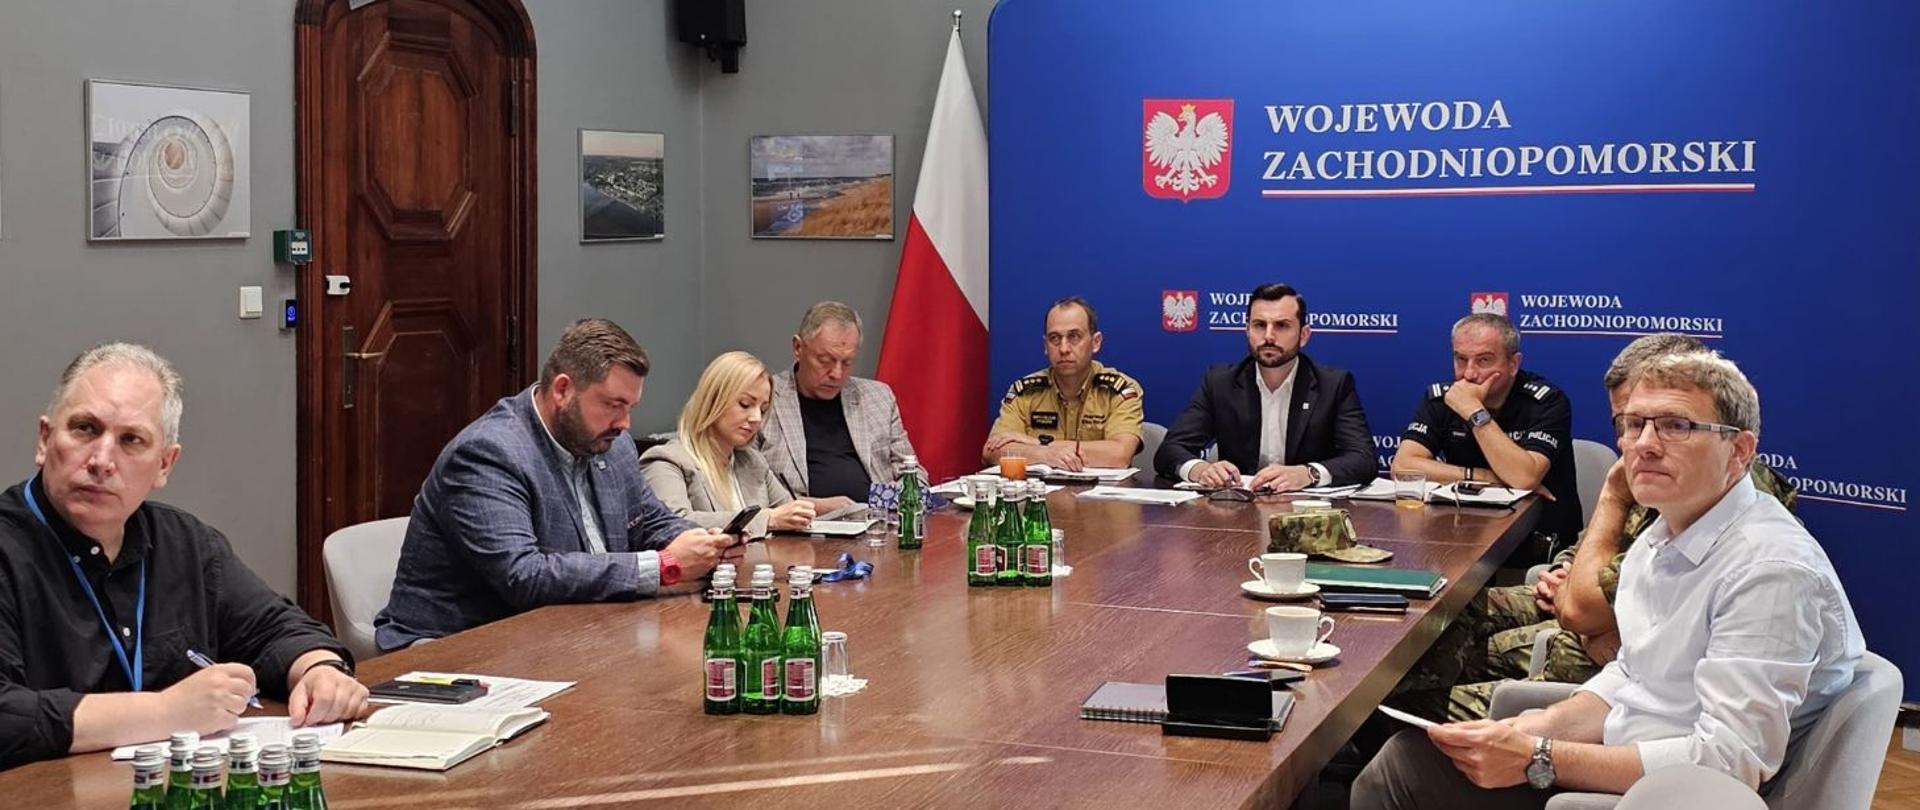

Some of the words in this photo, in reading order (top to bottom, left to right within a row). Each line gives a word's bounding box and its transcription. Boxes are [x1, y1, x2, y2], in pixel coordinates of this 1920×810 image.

[1265, 99, 1511, 133] WOJEWODA
[1262, 140, 1756, 180] ZACHODNIOPOMORSKI
[1520, 294, 1622, 309] WOJEWODA
[1520, 314, 1723, 332] ZACHODNIOPOMORSKI
[1787, 476, 1907, 503] OPOMORSKI
